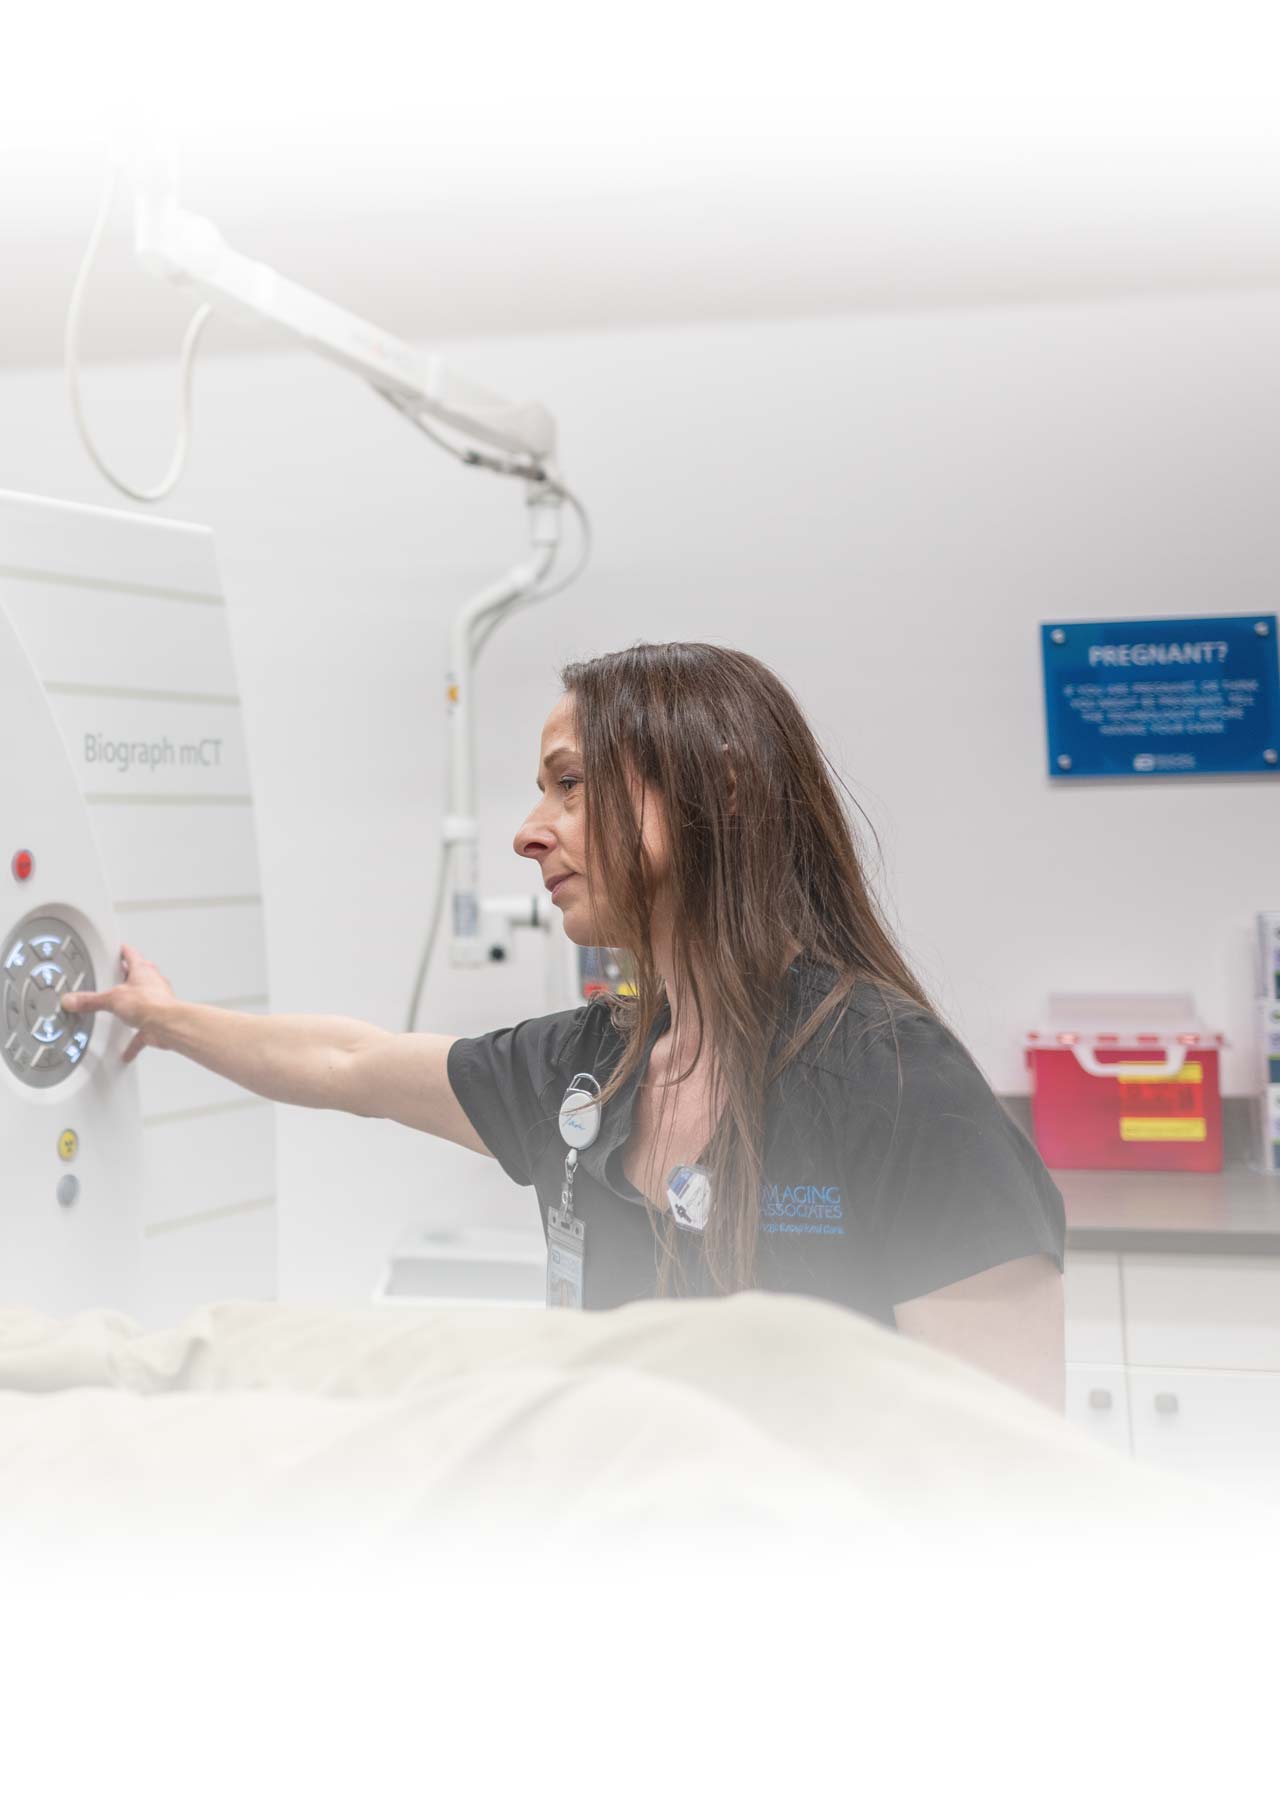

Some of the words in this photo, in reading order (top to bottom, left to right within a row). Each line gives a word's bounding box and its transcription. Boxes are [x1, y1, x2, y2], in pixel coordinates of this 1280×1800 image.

[1088, 641, 1228, 667] PREGNANT?
[84, 733, 175, 773] Biograph
[179, 738, 224, 767] mCT
[761, 1184, 841, 1205] MAGING
